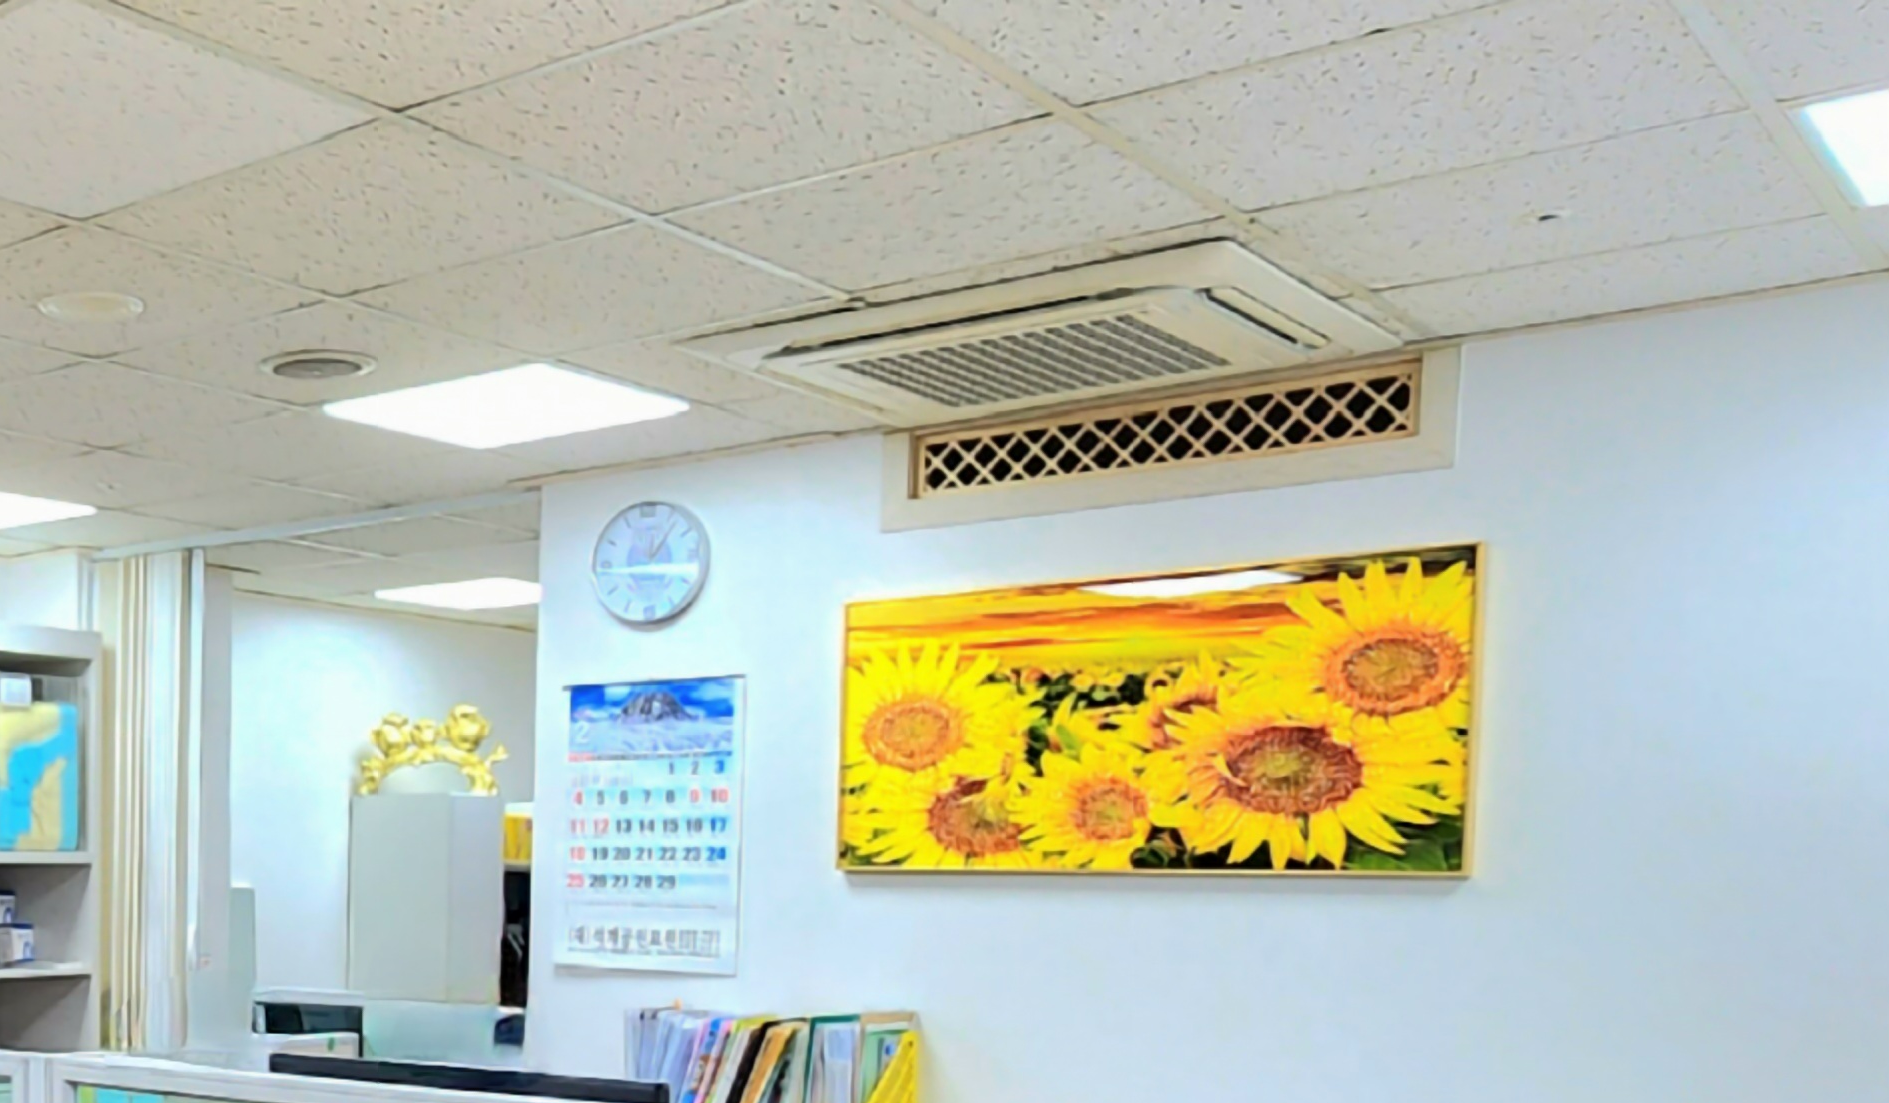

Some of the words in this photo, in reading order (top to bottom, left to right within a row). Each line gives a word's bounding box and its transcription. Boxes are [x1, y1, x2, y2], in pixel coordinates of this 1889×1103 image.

[692, 760, 699, 775] 2
[575, 791, 582, 804] 4
[597, 790, 604, 805] 5
[643, 790, 651, 803] 7
[711, 789, 728, 803] 10
[571, 819, 585, 833] 11
[594, 819, 608, 833] 12
[616, 818, 631, 833] 13
[639, 819, 655, 833] 14
[663, 819, 678, 833] 15
[710, 817, 726, 832] 17
[593, 847, 608, 860] 19
[613, 847, 630, 860] 20
[636, 847, 652, 860] 21
[658, 847, 676, 860] 22
[683, 847, 701, 861] 23
[706, 847, 726, 860] 24
[589, 875, 607, 887] 26
[611, 875, 628, 887] 27
[633, 875, 651, 888] 28
[657, 875, 675, 888] 29
